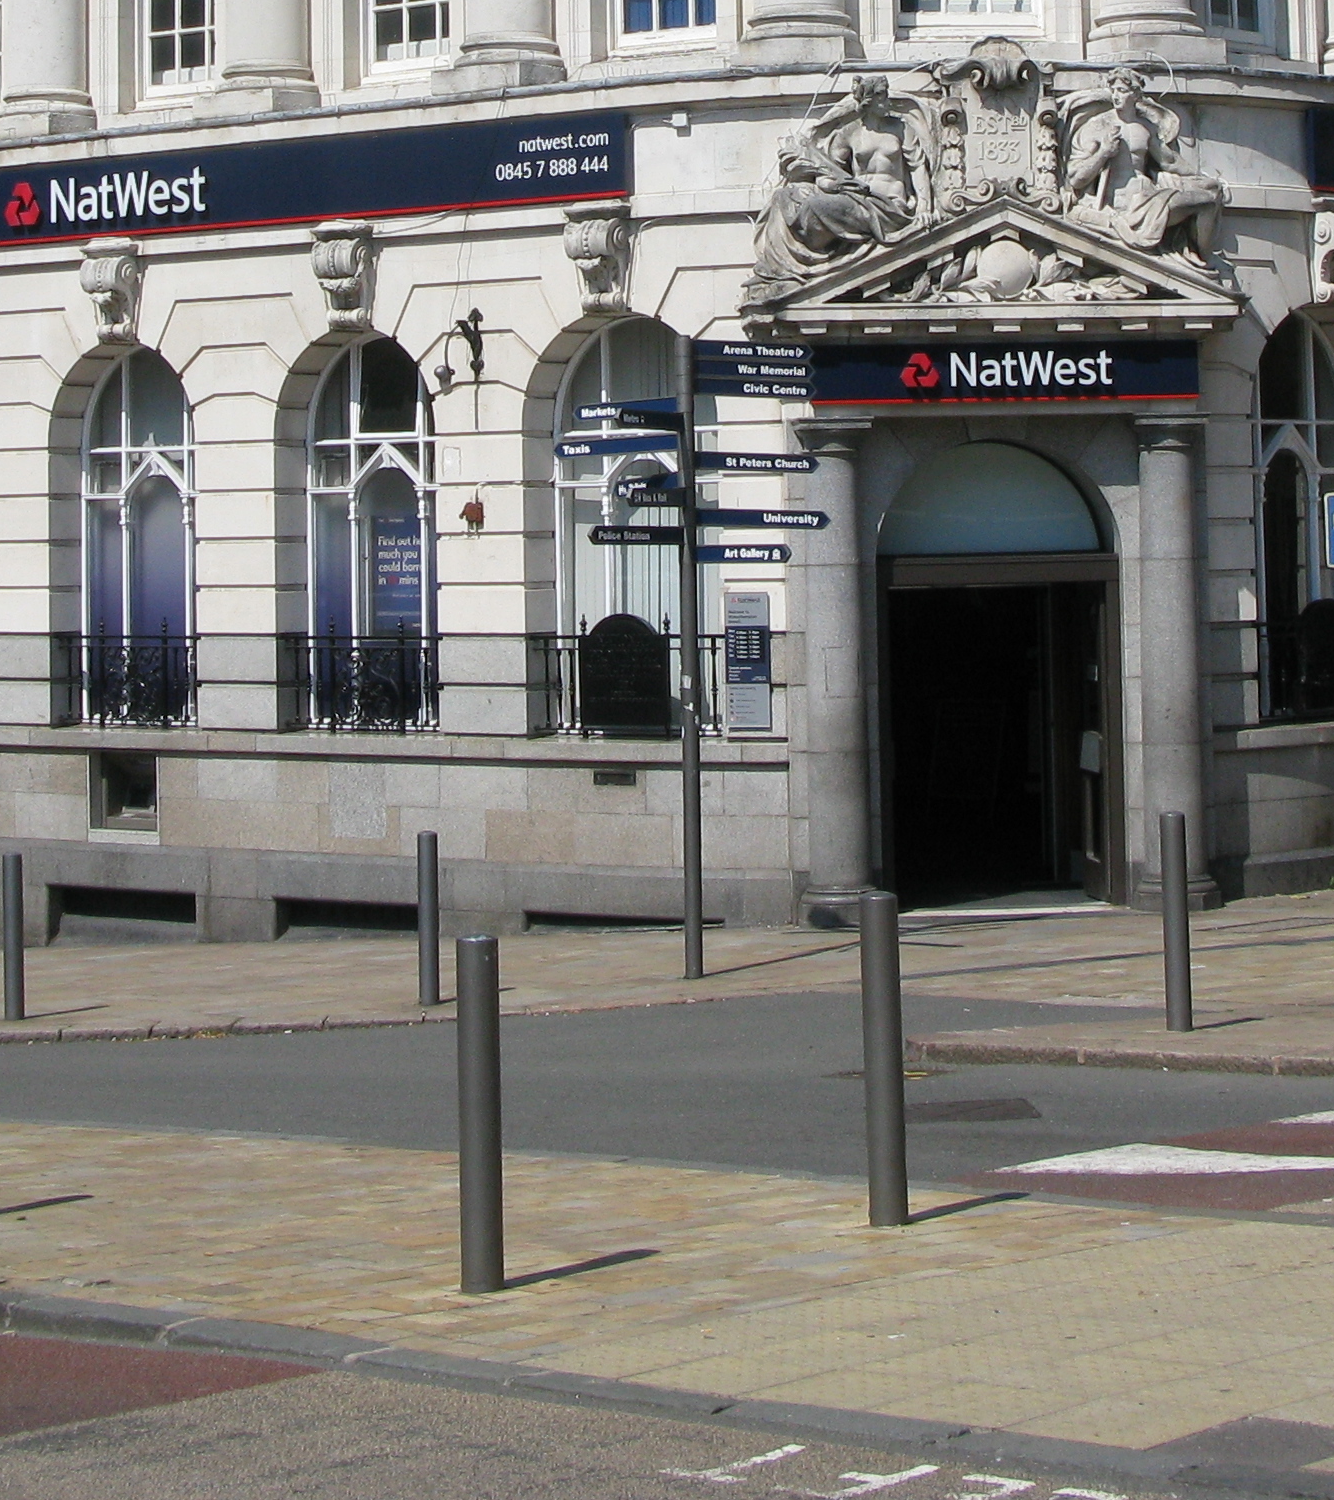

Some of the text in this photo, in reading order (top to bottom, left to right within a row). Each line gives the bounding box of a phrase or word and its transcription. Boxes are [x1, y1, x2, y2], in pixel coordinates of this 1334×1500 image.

[518, 131, 609, 153] natwest.com
[977, 140, 1022, 164] 1833
[495, 155, 609, 182] 0845 7 888 444
[49, 165, 207, 224] NatWest
[723, 345, 795, 357] Arena Theatre
[738, 365, 806, 377] War Memorial
[948, 349, 1113, 388] NatWest
[743, 384, 807, 396] Civic Centre
[581, 406, 616, 419] Markets
[562, 444, 591, 455] Taxis
[726, 457, 810, 470] St Peters Church
[763, 513, 819, 526] University
[378, 536, 395, 546] Find
[397, 537, 411, 546] out
[378, 549, 418, 563] much you
[724, 548, 770, 561] Art Gallery
[378, 562, 400, 572] could
[378, 575, 387, 585] in
[399, 576, 419, 585] mins
